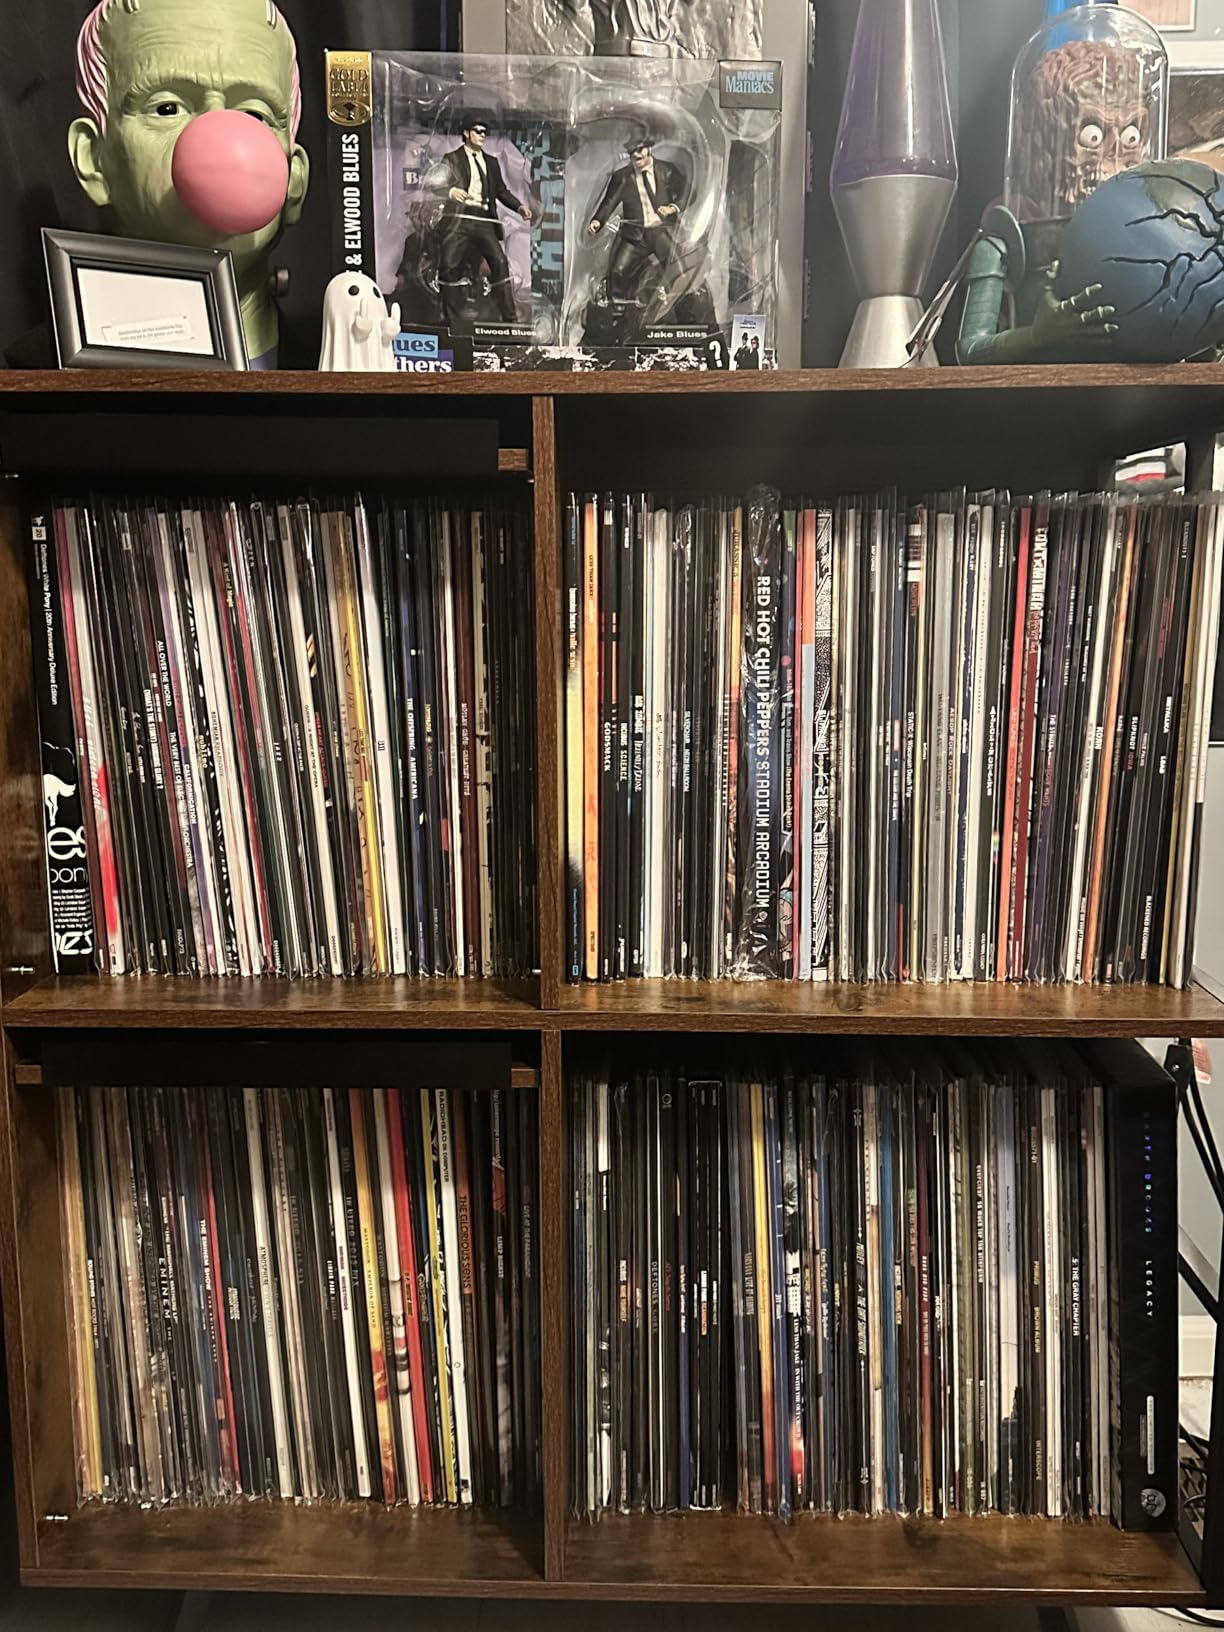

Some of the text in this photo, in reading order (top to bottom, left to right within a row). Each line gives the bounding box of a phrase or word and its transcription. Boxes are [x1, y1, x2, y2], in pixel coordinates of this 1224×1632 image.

[725, 76, 775, 94] Maniacs
[736, 71, 774, 81] MOVIE
[341, 133, 360, 185] BLUES
[343, 186, 362, 250] ELWOOD
[475, 328, 510, 336] Elwood
[39, 544, 48, 573] Deftones
[43, 592, 52, 608] Pony
[45, 612, 54, 626] 20th
[46, 627, 56, 661] Anniversary
[157, 641, 165, 652] ALL
[49, 662, 58, 682] Deluxe
[159, 653, 167, 671] OVER
[50, 684, 59, 705] Edition
[163, 683, 172, 706] WORLD
[169, 731, 177, 742] THE
[210, 711, 219, 741] BOHEMIAN
[408, 713, 416, 751] OFFSPRING
[907, 711, 915, 738] STATIC-X
[1128, 716, 1139, 750] SLIPKNOT
[171, 744, 179, 760] VERY
[199, 735, 208, 769] sublime
[273, 742, 282, 762] JAZZ
[755, 575, 770, 908] RED HOT CHILI PEPPERS STADIUM ARCADIUM
[906, 740, 914, 768] Wisconsin
[173, 761, 181, 775] BEST
[410, 757, 418, 800] AMERICANA
[184, 763, 196, 825] CALIFORNICATION
[1139, 696, 1173, 960] METALLICA LOAD BLACKENED RECORDINGS
[183, 831, 193, 868] ORCHESTRA
[439, 1090, 447, 1143] RADIOHEAD
[442, 1152, 450, 1183] COMPUTER
[201, 1236, 209, 1266] EMINEM
[458, 1196, 471, 1289] THE GLORIOUS SONS
[203, 1268, 211, 1290] SHOW
[259, 1246, 269, 1286] ATMOSPHERE
[159, 1257, 171, 1319] EMINEM
[1072, 1282, 1080, 1302] GRAY
[1145, 1260, 1153, 1317] LEGACY
[1072, 1302, 1080, 1336] CHAPTER
